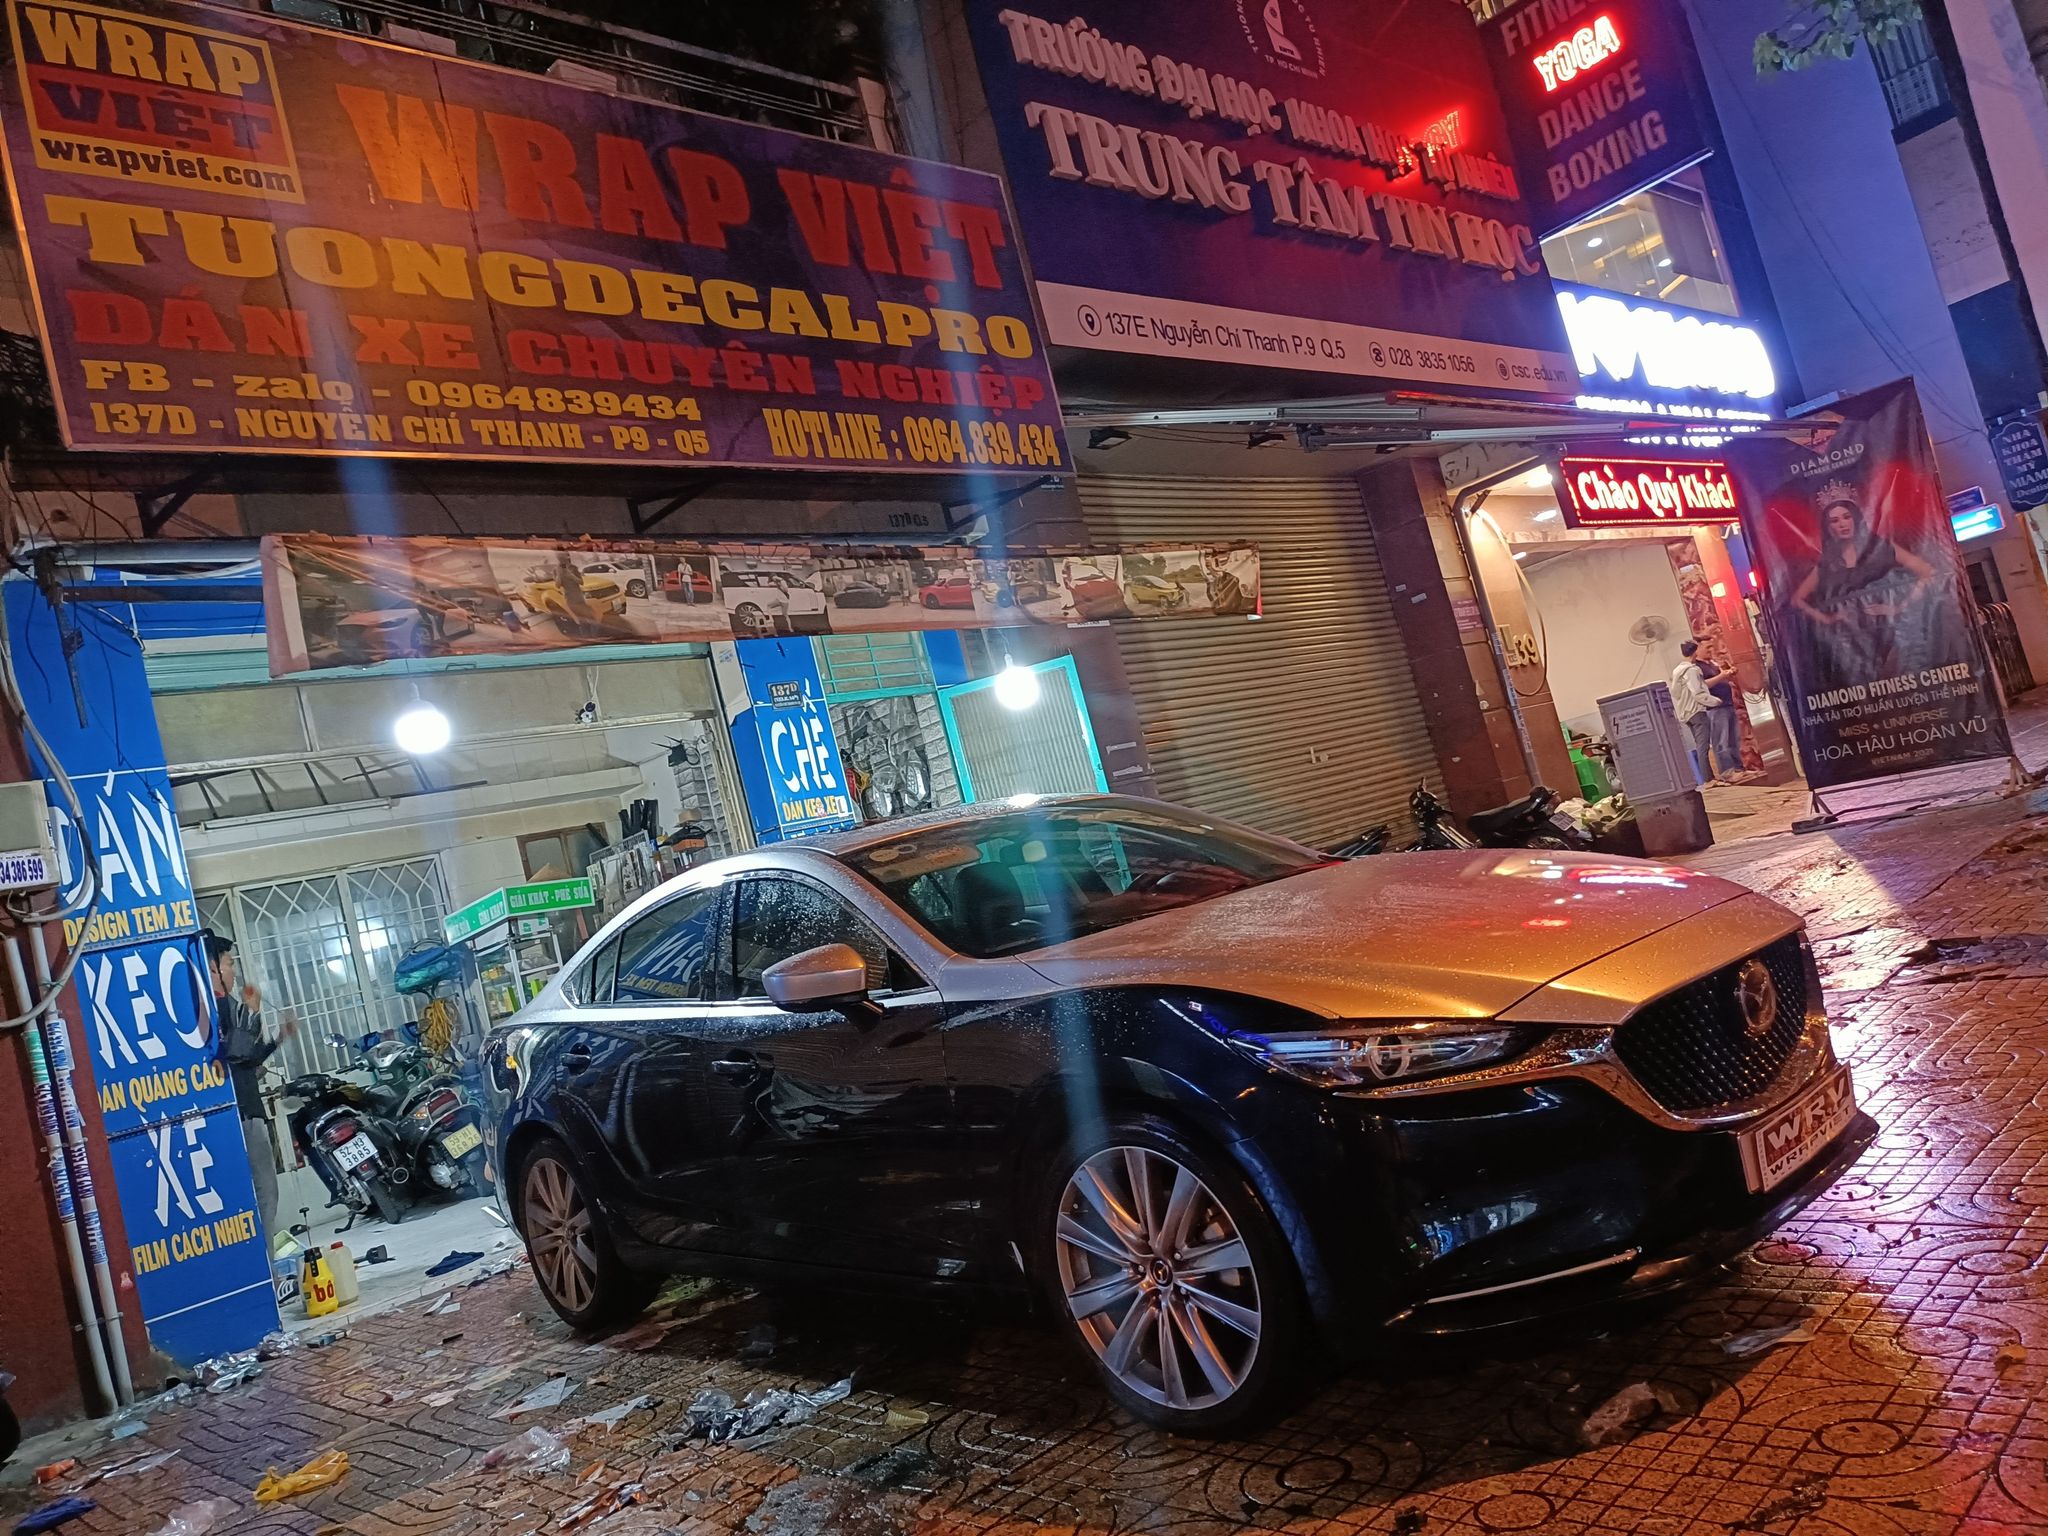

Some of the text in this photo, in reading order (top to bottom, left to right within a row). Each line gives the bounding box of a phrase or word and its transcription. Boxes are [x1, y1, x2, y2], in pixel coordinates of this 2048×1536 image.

[25, 7, 261, 97] WRAP
[1500, 0, 1604, 57] FITN
[1532, 15, 1622, 93] YOGA
[38, 79, 273, 149] VIỆT
[1151, 55, 1216, 120] ĐẠI
[1210, 73, 1282, 137] HỌC
[1284, 97, 1367, 157] KHOA
[1537, 59, 1647, 149] DANCE
[40, 138, 298, 194] wrapviet.com
[1546, 110, 1669, 203] BOXING
[336, 84, 1007, 305] WRAP VIỆT
[1023, 101, 1541, 282] TRUNG TÂM TIN HỌC
[43, 194, 1035, 360] TUONGDECALPRO
[65, 287, 1045, 417] DÁN XE CHUYÊN NGHIỆP
[1105, 311, 1346, 360] 137E Nguyễn Chí Thanh P.9 Q.5
[1388, 346, 1476, 374] 028 3835 1056
[80, 359, 171, 393] FB
[406, 379, 702, 422] 0964839434
[1511, 365, 1569, 384] csc.edu.vn
[90, 402, 198, 435] 137D
[234, 400, 393, 443] NGUYỄN
[402, 411, 465, 445] CHÍ
[470, 418, 586, 449] THANH
[610, 425, 651, 452] P9
[675, 429, 711, 457] Q5
[762, 407, 888, 461] HOTLINE
[903, 416, 1062, 467] 0964.839.434
[2001, 438, 2039, 456] KHOA
[1790, 443, 1865, 475] DIAMOND
[1577, 464, 1640, 511] Chào
[1638, 466, 1684, 518] Quý
[771, 683, 798, 697] 137D
[1807, 662, 1971, 711] DIAMOND FITNESS CENTER
[1814, 714, 1988, 762] HOA HẬU HOÀN VŨ
[1838, 707, 1950, 738] MISS UNIVERSE
[782, 796, 805, 823] DÁN
[823, 794, 838, 815] XE
[131, 903, 169, 935] TEM
[169, 899, 195, 928] XE
[98, 1056, 226, 1114] ÁN QUẢNG CÁO
[139, 1101, 224, 1228] XE
[345, 1146, 371, 1167] 3885
[1769, 1104, 1850, 1176] WRAPVIET
[132, 1207, 257, 1276] FILM CÁCH NHIỆT
